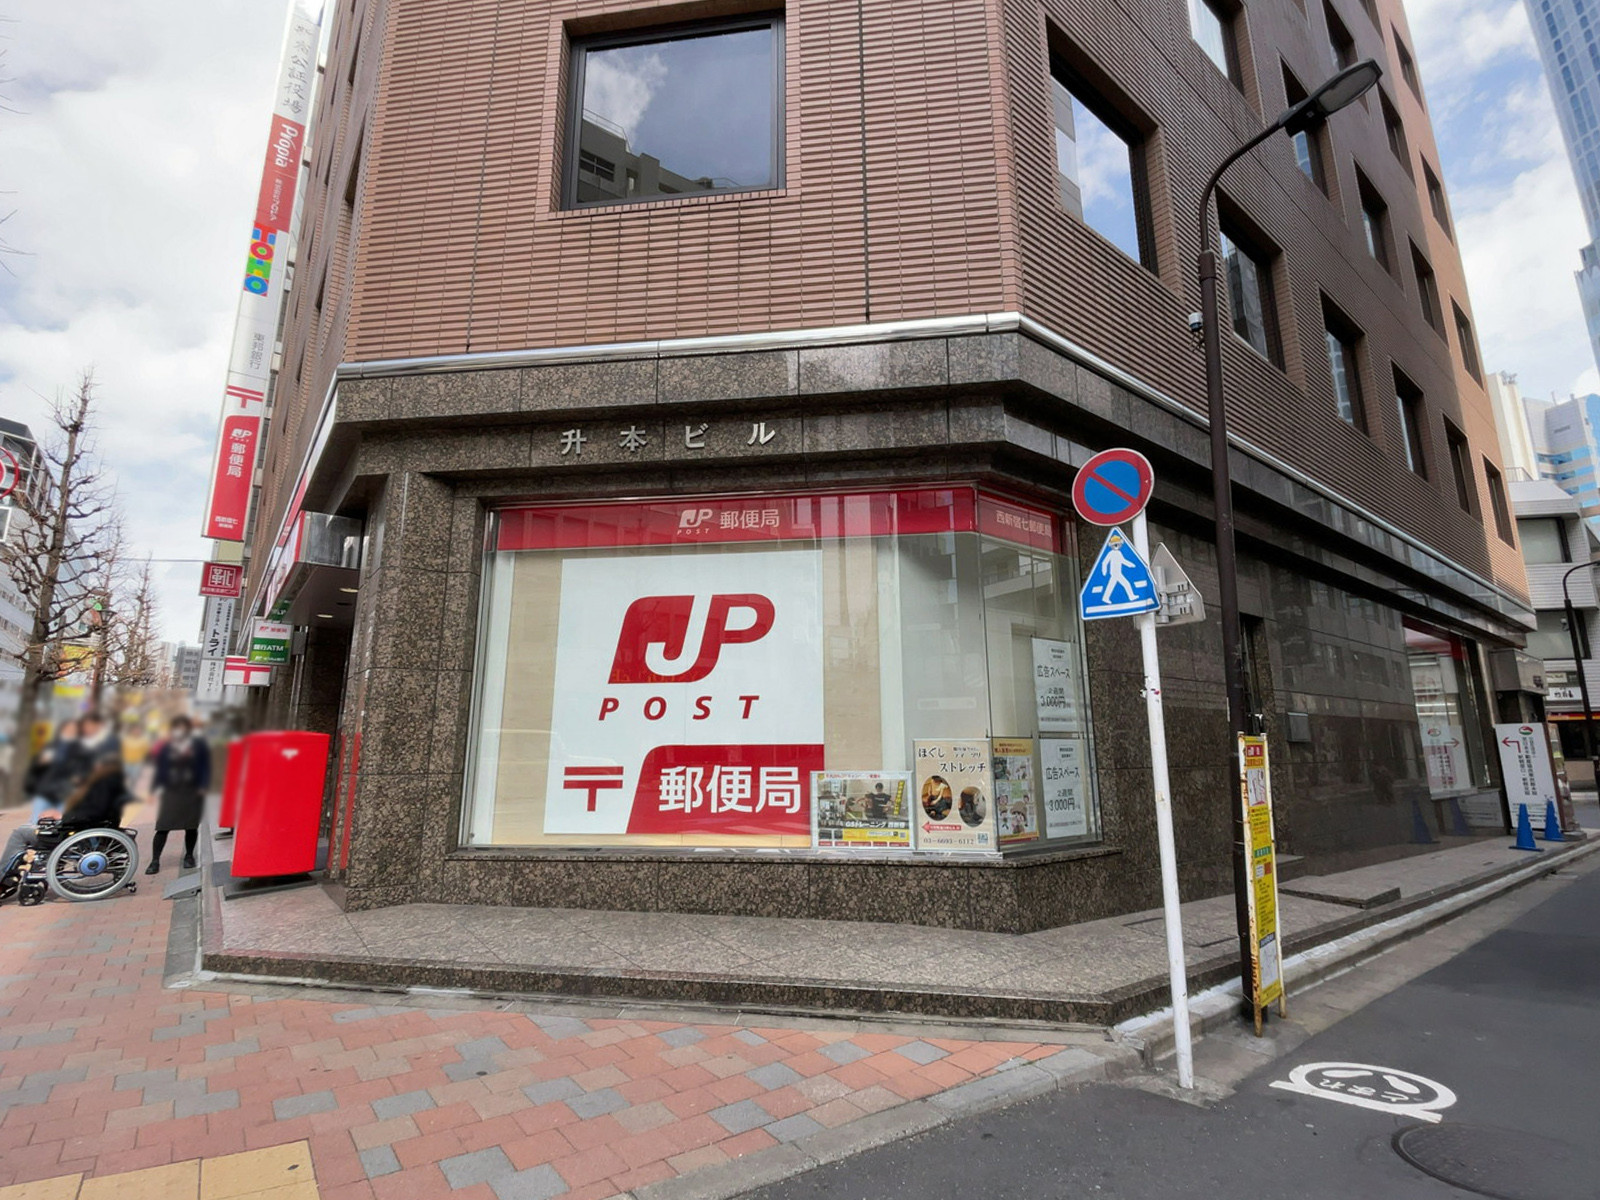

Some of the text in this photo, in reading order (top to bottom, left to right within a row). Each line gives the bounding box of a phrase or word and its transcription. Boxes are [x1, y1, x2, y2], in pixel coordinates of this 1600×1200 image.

[275, 123, 298, 168] Propia
[560, 422, 776, 455] 升本ビル
[226, 442, 246, 478] 郵便局
[678, 508, 713, 528] JP
[719, 509, 780, 530] 郵便局
[677, 527, 710, 535] POST
[212, 567, 233, 586] 靴
[608, 593, 776, 684] JP
[1037, 665, 1071, 678] 広告スペース
[598, 695, 760, 721] POST
[918, 747, 945, 758] ほぐし
[940, 762, 986, 773] ストレッチ
[1045, 767, 1080, 780] 広告スペース
[658, 765, 801, 814] 郵便局
